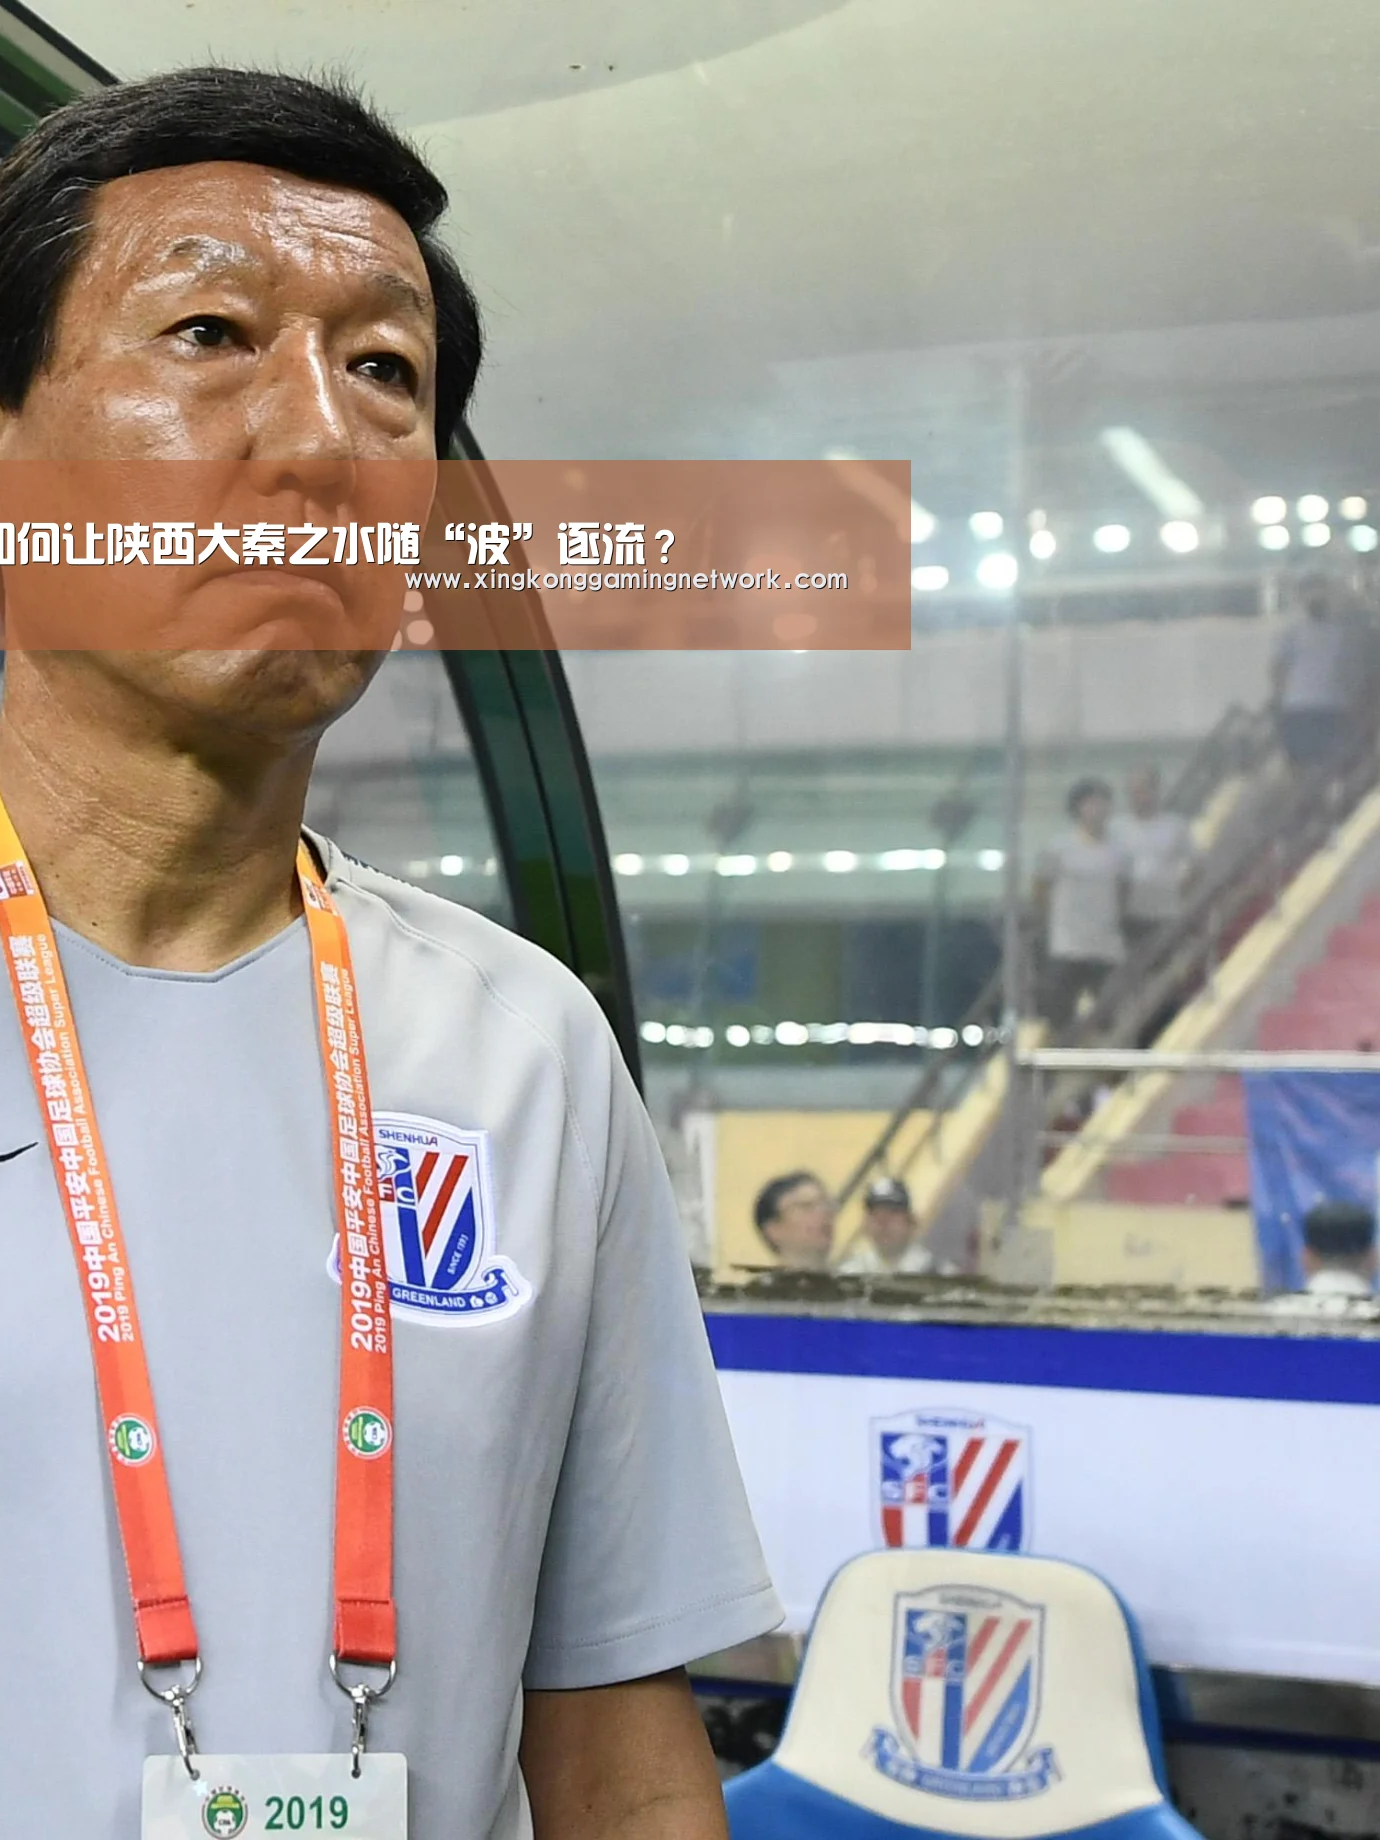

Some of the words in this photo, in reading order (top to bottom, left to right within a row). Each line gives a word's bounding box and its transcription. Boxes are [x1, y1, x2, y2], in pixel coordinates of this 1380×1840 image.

[36, 934, 56, 985] League
[49, 987, 66, 1028] Super
[341, 968, 355, 1014] League
[347, 1017, 359, 1056] Super
[60, 1032, 87, 1115] Association
[352, 1059, 370, 1136] Association
[8, 934, 121, 1343] 2019中国平安中国足球协会超级联赛
[74, 1118, 99, 1176] Football
[378, 1128, 438, 1148] SHENHUA
[359, 1139, 375, 1196] Football
[94, 1178, 115, 1239] Chinese
[368, 1198, 380, 1255] Chinese
[107, 1242, 120, 1263] An
[372, 1257, 383, 1278] An
[113, 1267, 125, 1301] Ping
[373, 1279, 388, 1313] Ping
[392, 1287, 467, 1309] GREENLAND
[118, 1305, 134, 1342] 2019
[374, 1316, 388, 1354] 2019
[264, 1795, 349, 1830] 2019
